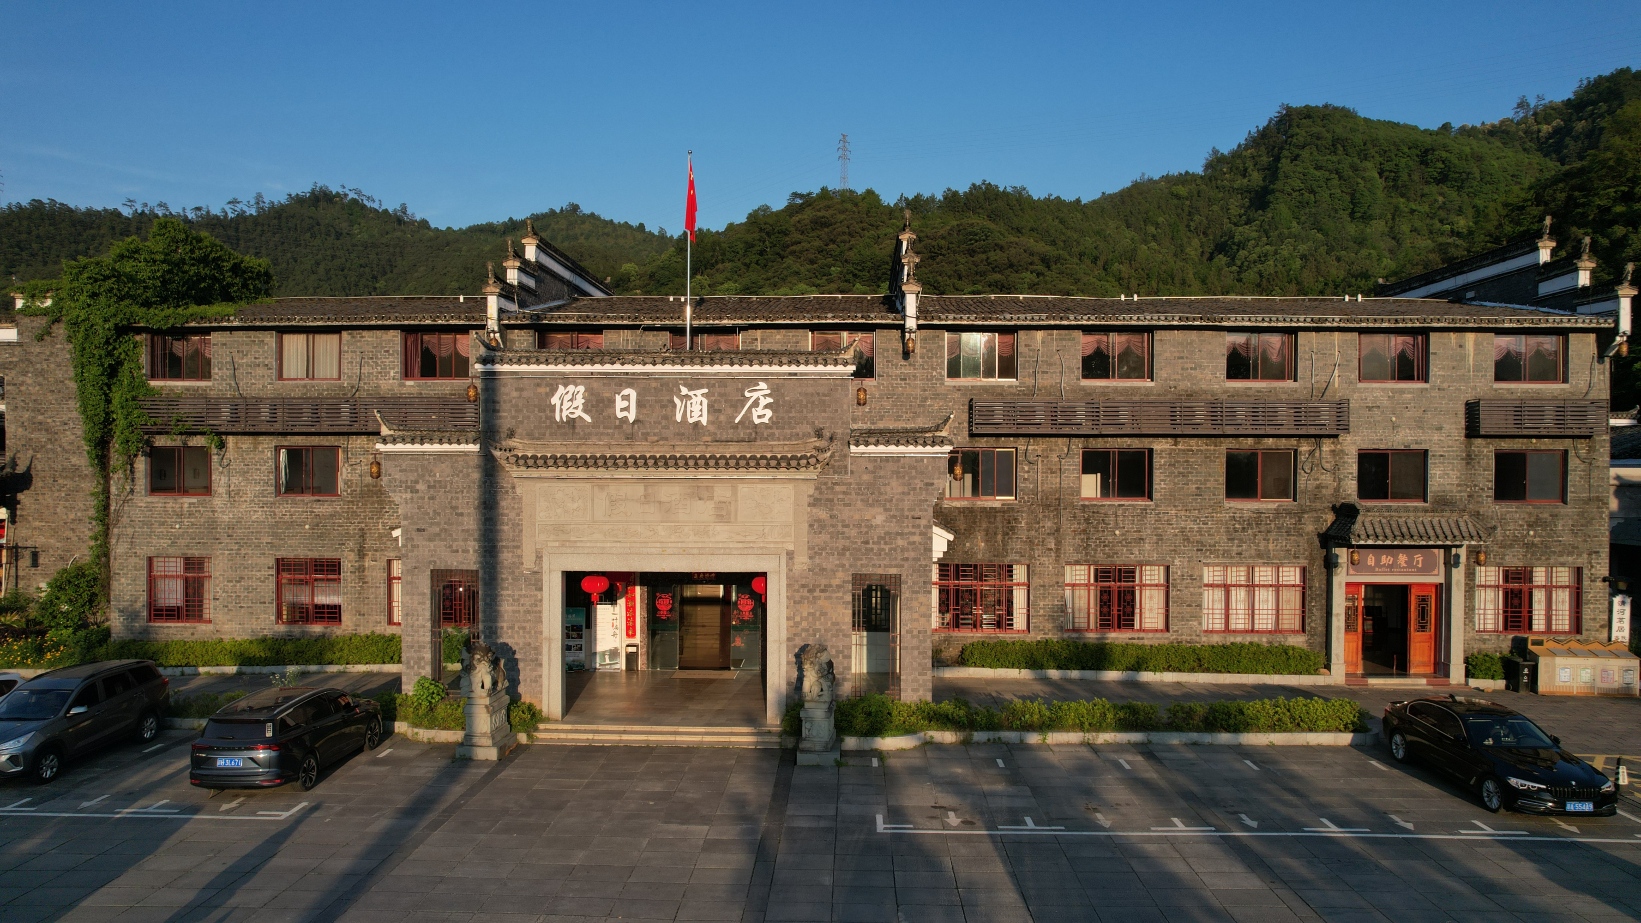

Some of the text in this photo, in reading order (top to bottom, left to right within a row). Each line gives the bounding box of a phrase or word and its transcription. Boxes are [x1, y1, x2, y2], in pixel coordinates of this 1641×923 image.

[550, 381, 774, 426] 假日酒店
[1366, 553, 1424, 568] 自助餐厅
